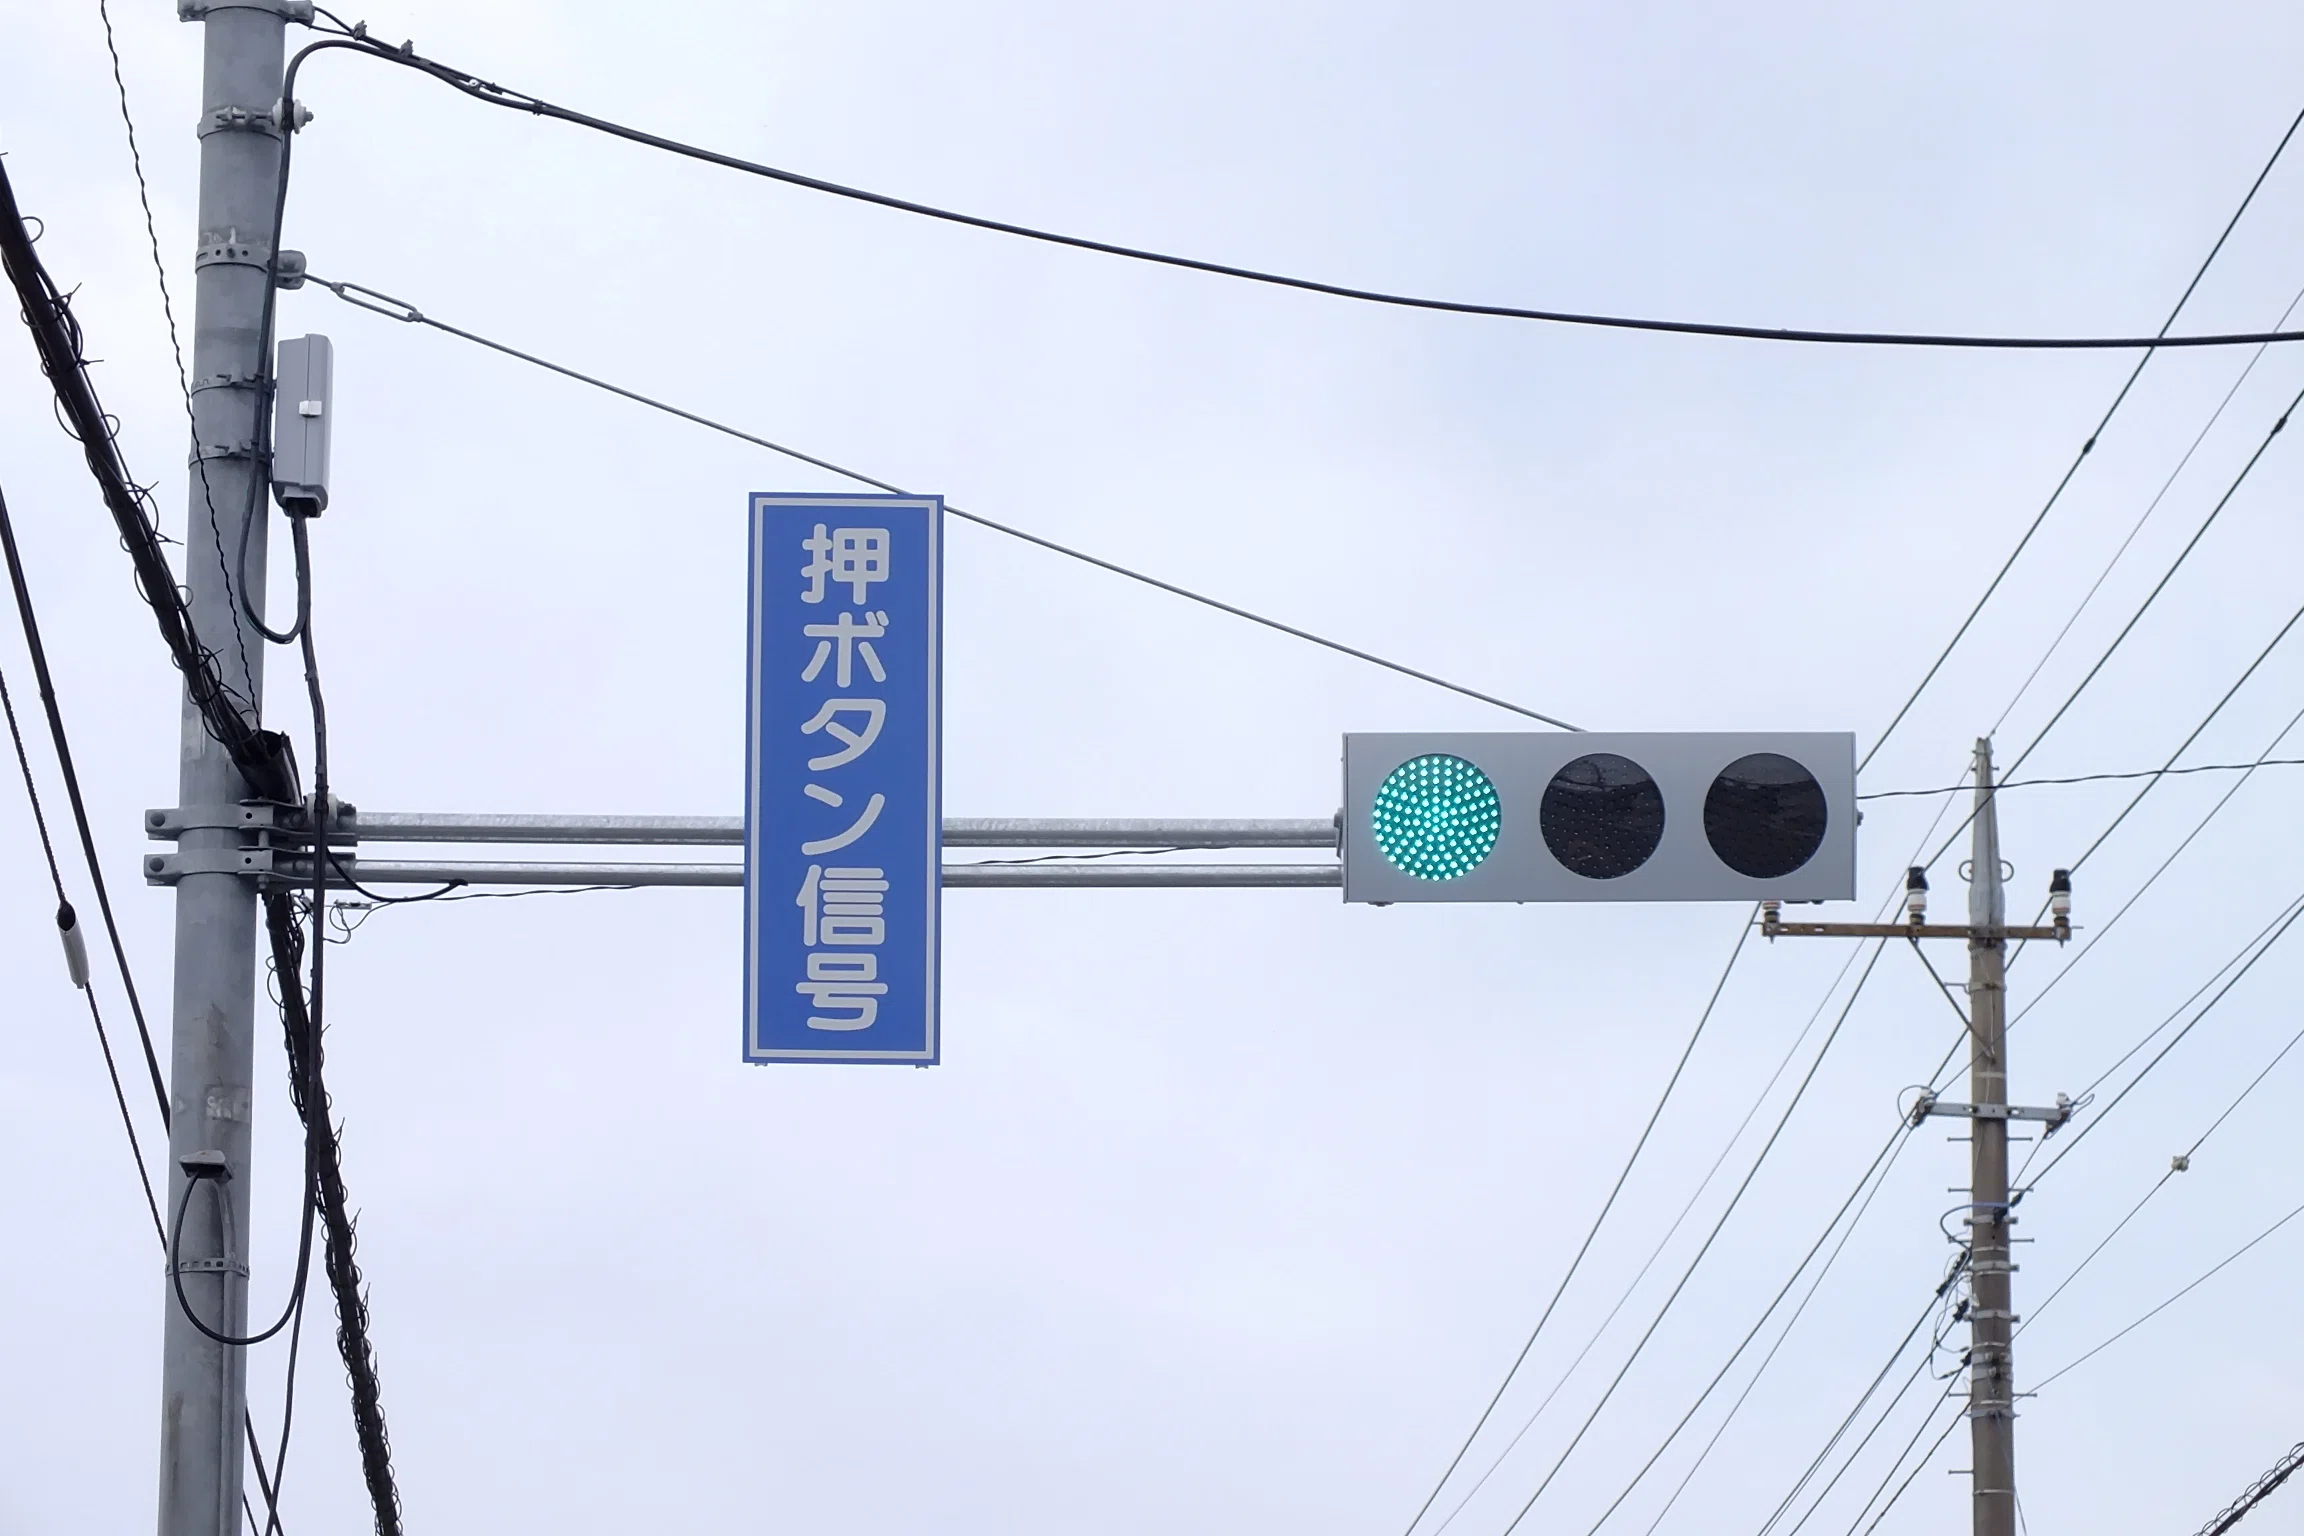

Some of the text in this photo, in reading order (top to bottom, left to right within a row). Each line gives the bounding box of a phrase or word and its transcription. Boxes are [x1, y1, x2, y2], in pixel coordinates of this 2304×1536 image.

[796, 523, 890, 1031] 押ボタン信号
